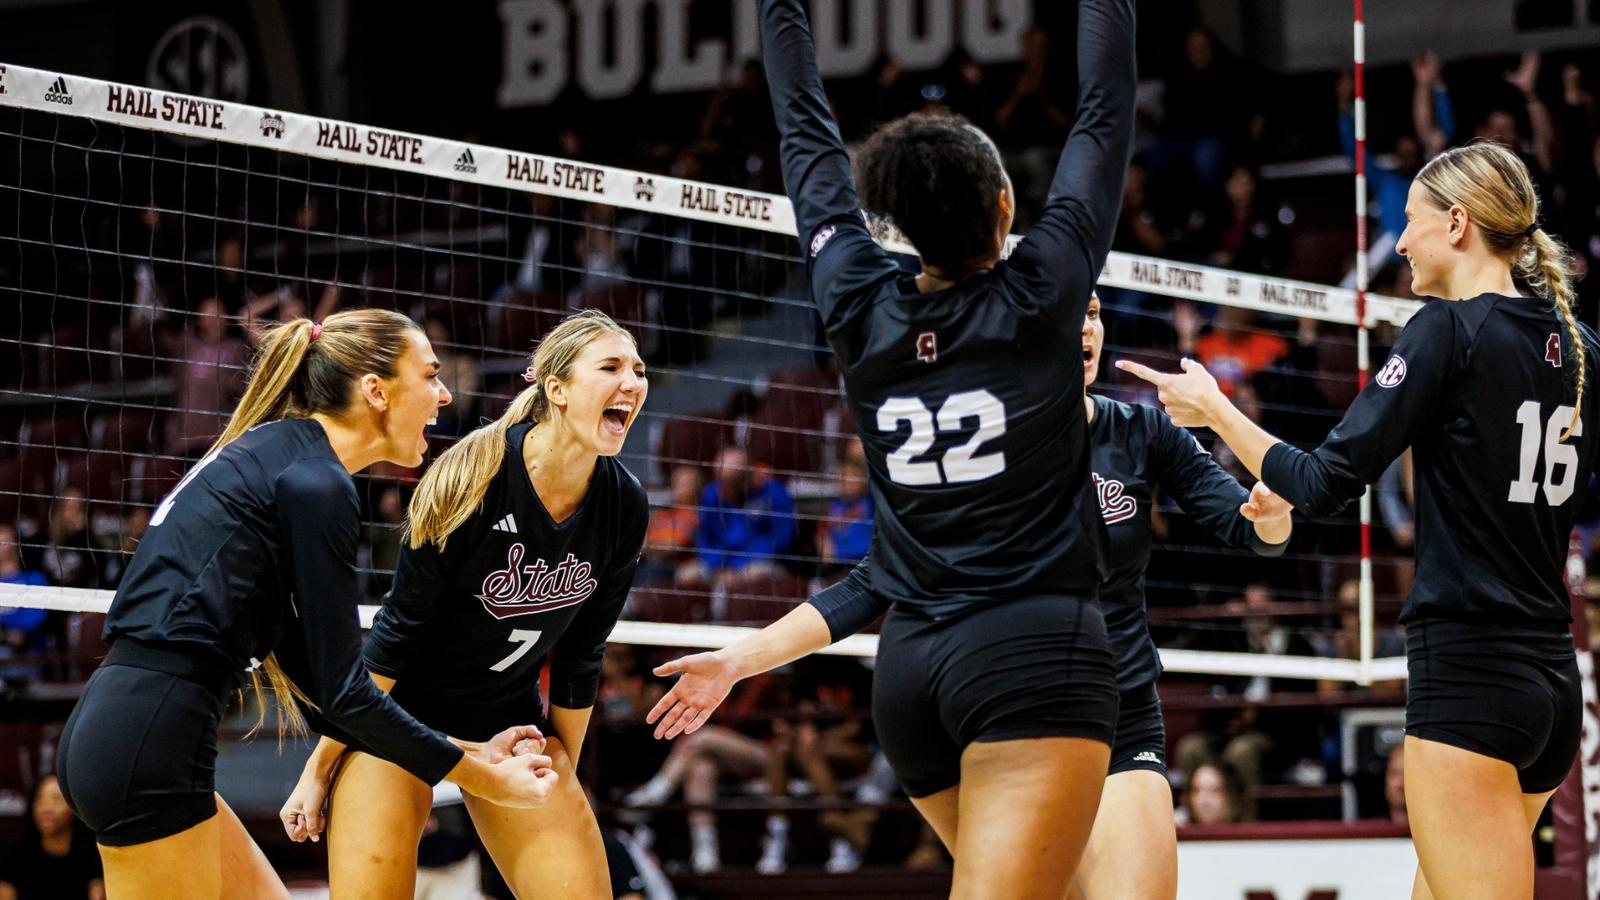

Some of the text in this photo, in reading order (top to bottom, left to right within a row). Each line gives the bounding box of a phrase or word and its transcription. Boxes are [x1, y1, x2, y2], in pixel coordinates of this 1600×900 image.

[45, 92, 73, 105] adidas
[107, 85, 225, 130] HAIL STATE
[316, 120, 423, 165] HAIL STATE
[506, 154, 605, 194] HAIL STATE
[680, 183, 772, 222] HAIL STATE
[876, 389, 1006, 486] 22
[1508, 400, 1583, 507] 16
[476, 543, 598, 616] State
[489, 628, 542, 672] 7
